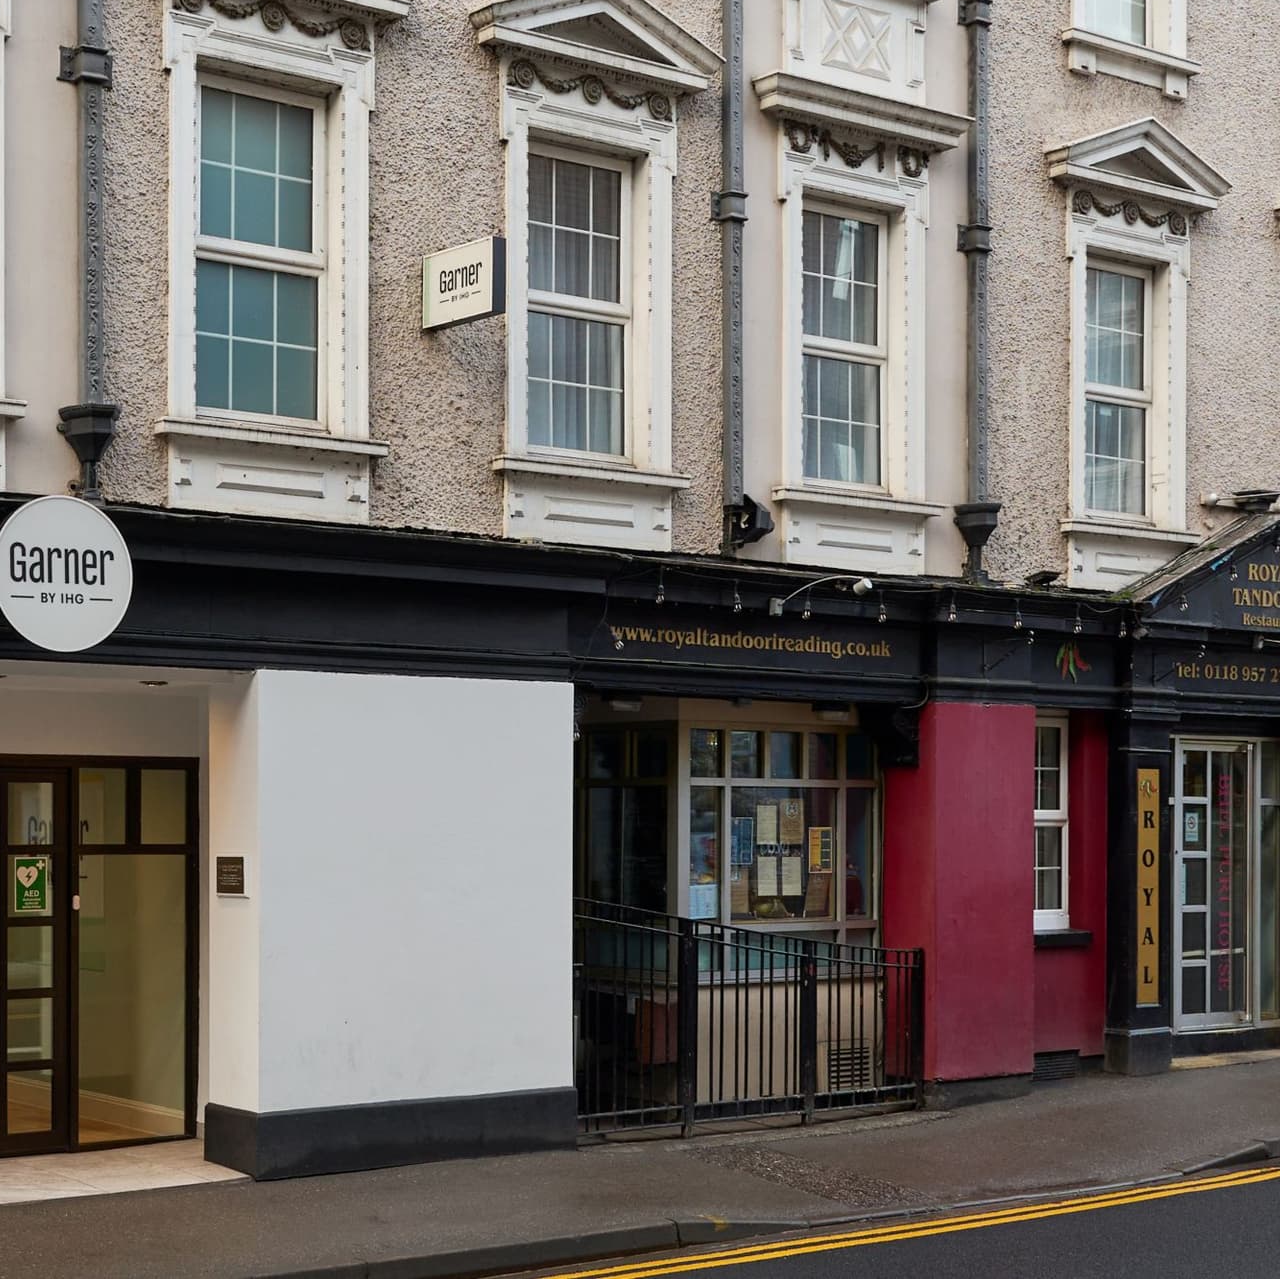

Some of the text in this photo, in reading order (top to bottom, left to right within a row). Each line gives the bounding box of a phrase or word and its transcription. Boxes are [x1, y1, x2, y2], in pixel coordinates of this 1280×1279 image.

[439, 261, 483, 294] Garner
[9, 541, 114, 586] Garner
[40, 592, 84, 604] BY IHG
[610, 624, 891, 659] www.royaltandoorireading.co.uk
[1173, 662, 1200, 679] Tel:
[1204, 663, 1238, 680] 0118
[1241, 667, 1267, 683] 957
[24, 889, 40, 897] AED
[1142, 810, 1155, 984] ROYAL
